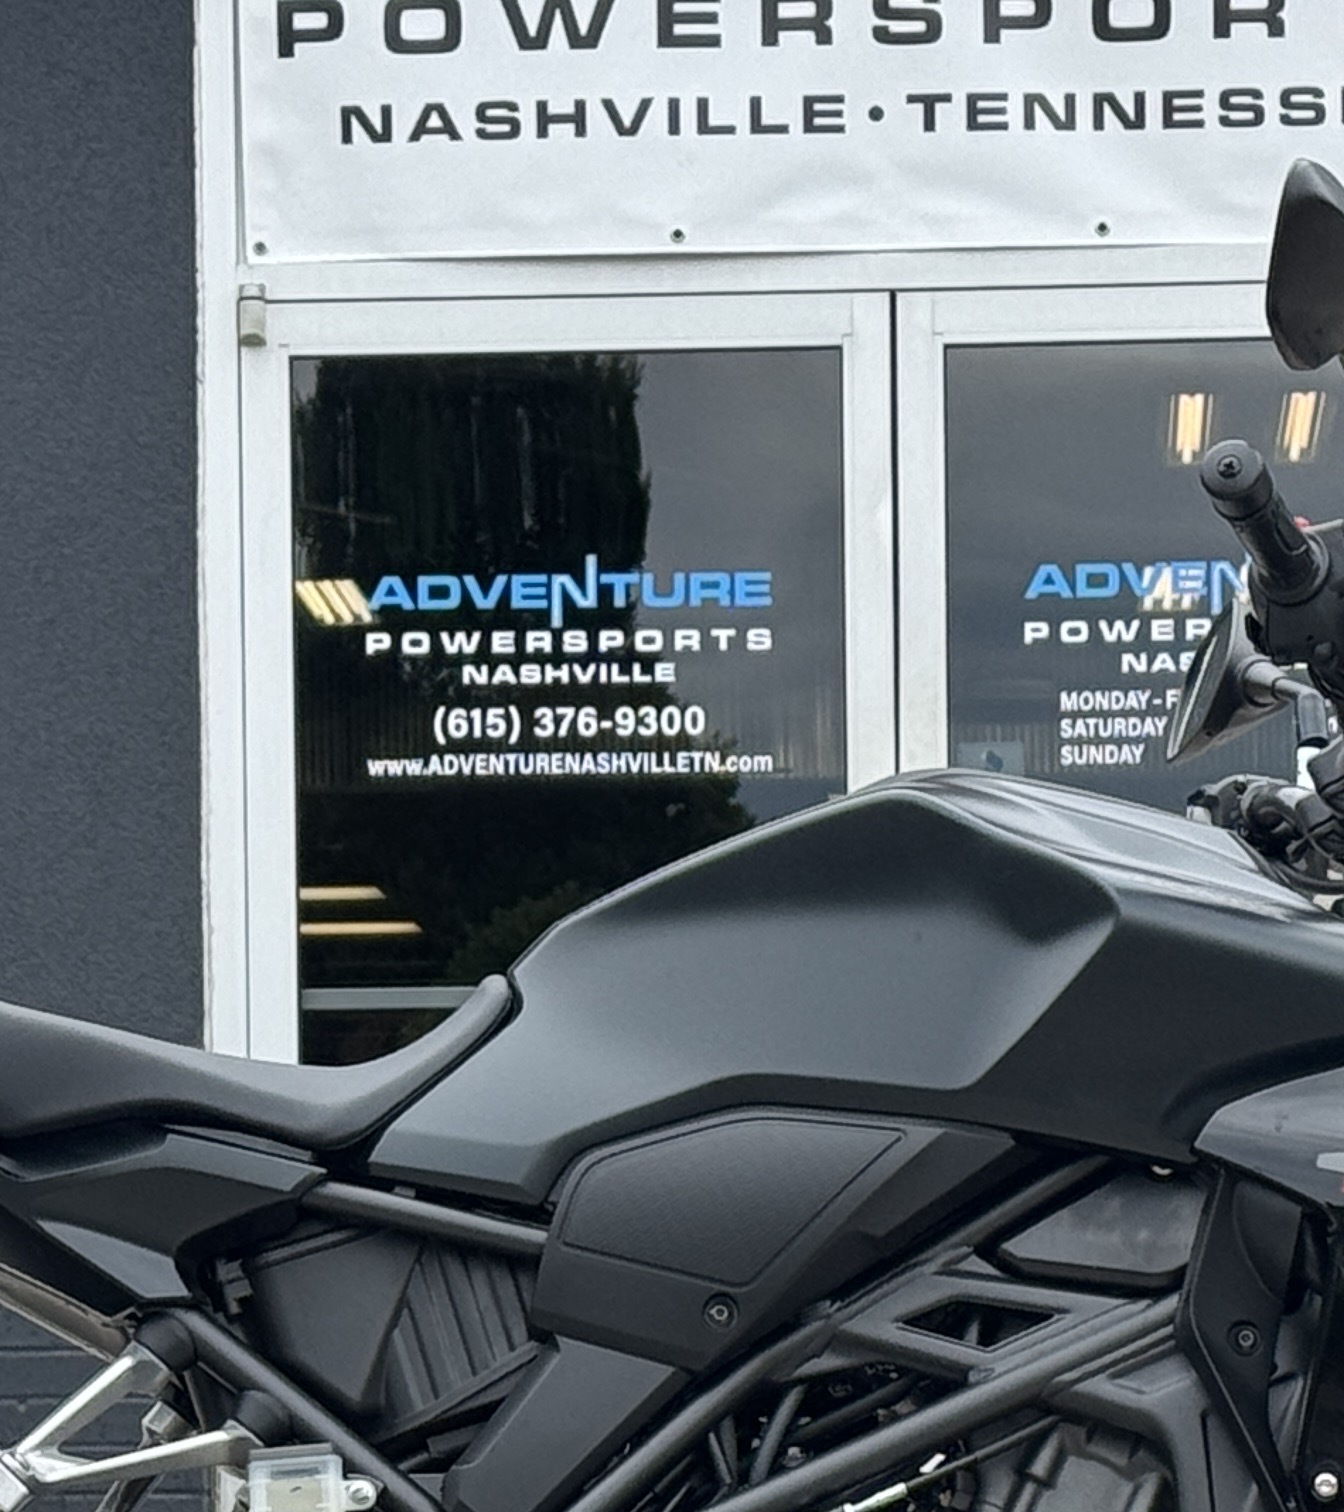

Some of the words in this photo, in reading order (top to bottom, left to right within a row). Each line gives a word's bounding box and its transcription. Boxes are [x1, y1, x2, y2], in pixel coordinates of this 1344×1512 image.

[340, 94, 846, 144] NASHVILLE
[367, 554, 773, 627] ADVENTURE
[1024, 553, 1253, 615] ADVEN
[365, 627, 773, 655] POWERSPORTS
[1024, 618, 1212, 645] POWER
[462, 662, 676, 685] NASHVILLE
[1121, 651, 1196, 674] NAS
[433, 704, 522, 744] (615)
[533, 704, 706, 738] 376-9300
[1060, 716, 1168, 739] SATURDAY
[367, 750, 774, 777] www.ADVENTURENASHVILLETN.com
[1060, 743, 1146, 766] SUNDAY
